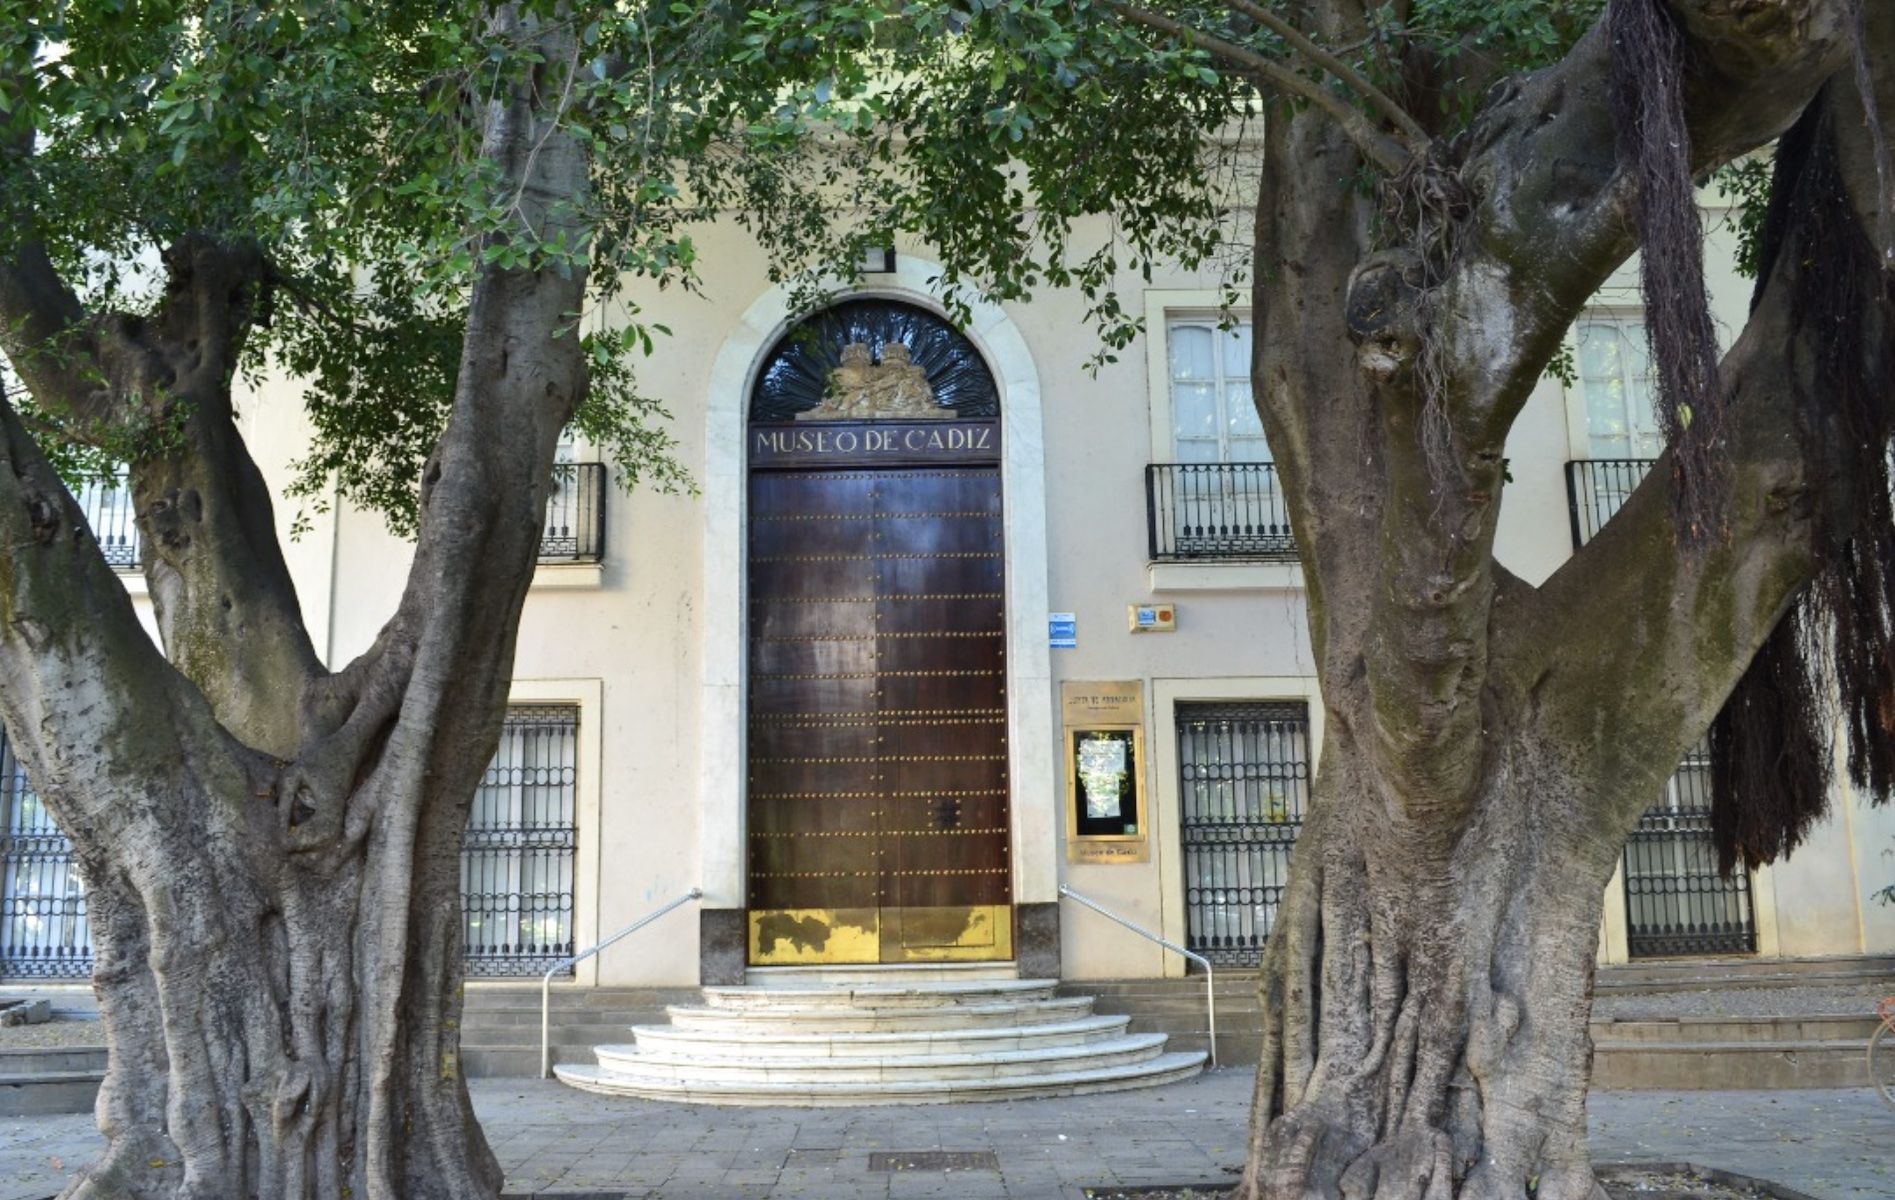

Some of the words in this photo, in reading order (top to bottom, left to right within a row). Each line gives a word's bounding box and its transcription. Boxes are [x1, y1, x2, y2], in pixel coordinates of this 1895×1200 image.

[757, 430, 857, 453] MUSEO
[865, 429, 899, 451] DE
[904, 428, 991, 450] CADIZ
